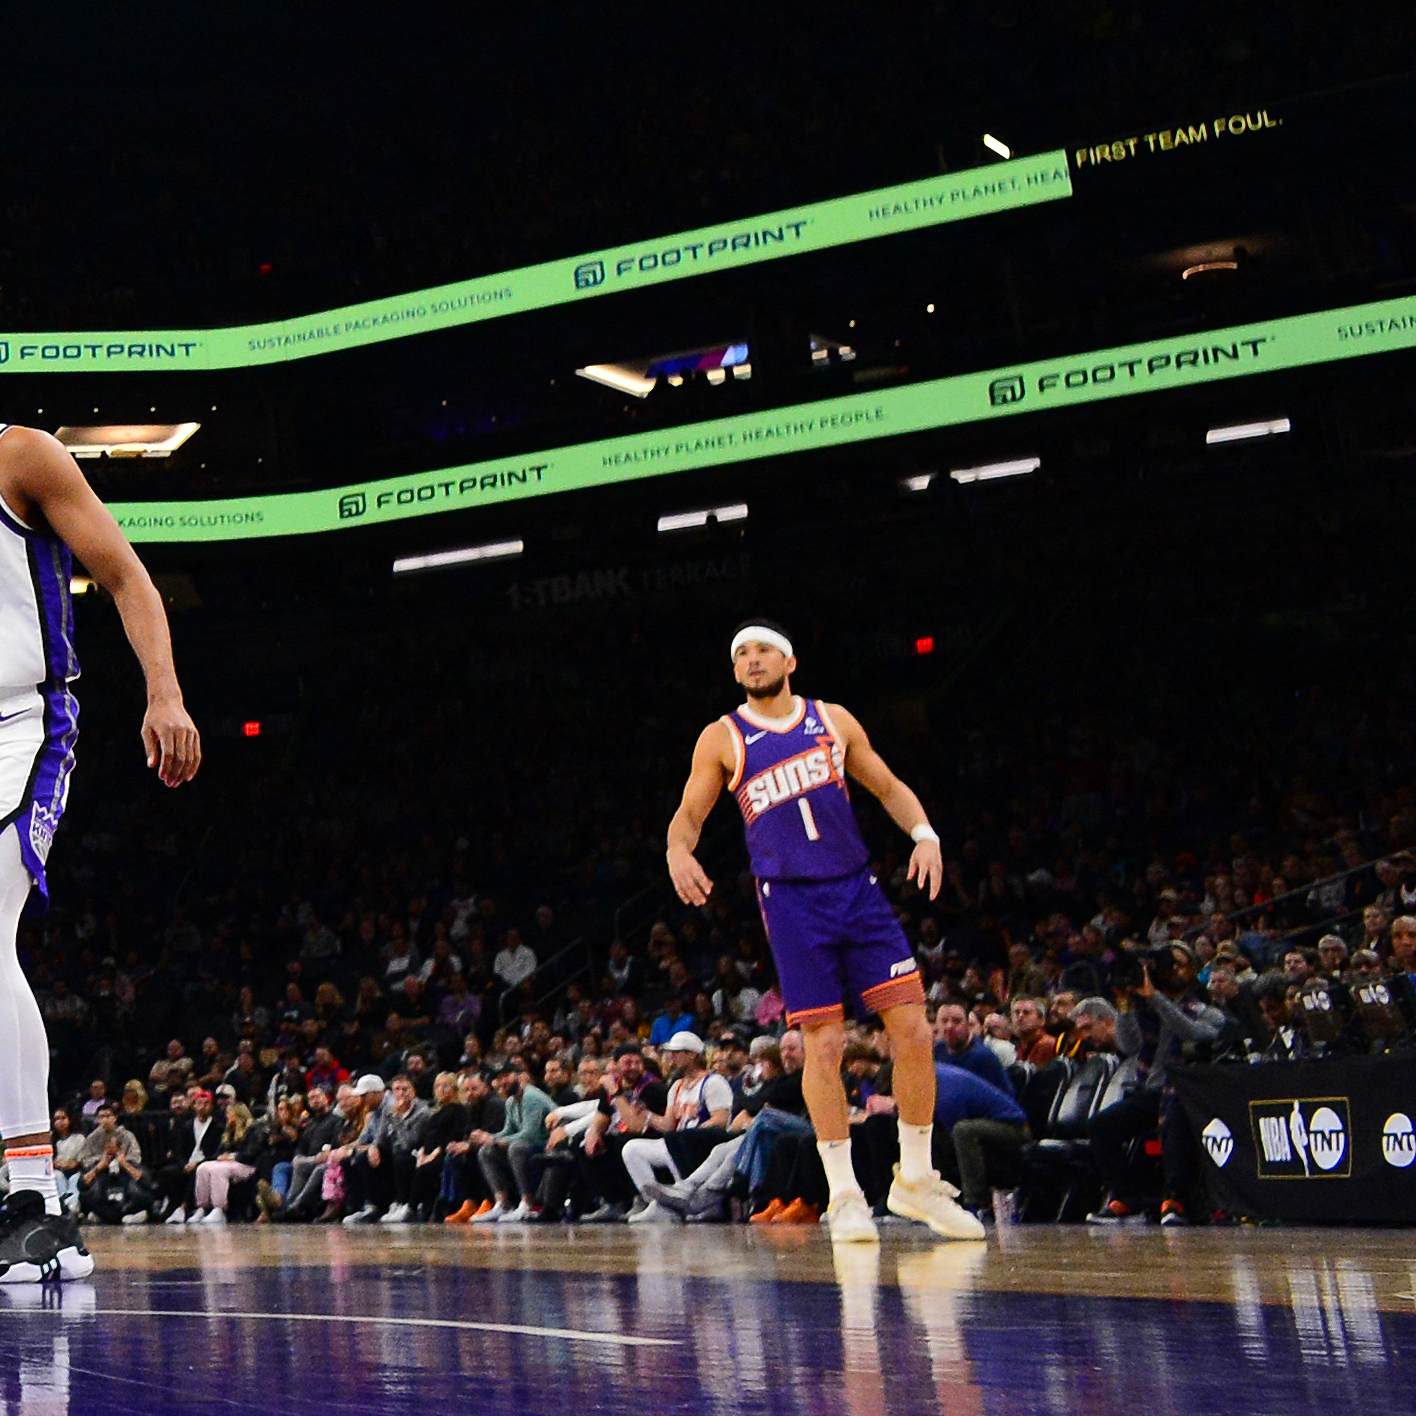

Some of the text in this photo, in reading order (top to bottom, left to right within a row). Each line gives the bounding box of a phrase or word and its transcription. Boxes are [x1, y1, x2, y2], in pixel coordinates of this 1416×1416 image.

[1075, 109, 1284, 170] FIRST TEAM FOUL.
[868, 192, 945, 222] HEALTHY
[615, 220, 808, 278] FOOTPRINT
[248, 286, 514, 352] SUSTAINABLE PACKAGING SOLUTIONS
[19, 342, 197, 361] FOOTPRINT
[1036, 337, 1268, 396] FOOTPRINT
[602, 442, 670, 468] HEALTHY
[742, 418, 815, 446] HEALTHY
[819, 406, 885, 430] PEOPLE
[376, 464, 548, 510] FOOTPRINT
[179, 510, 265, 528] SOLUTIONS
[746, 748, 831, 815] SUNS
[797, 797, 820, 842] 1
